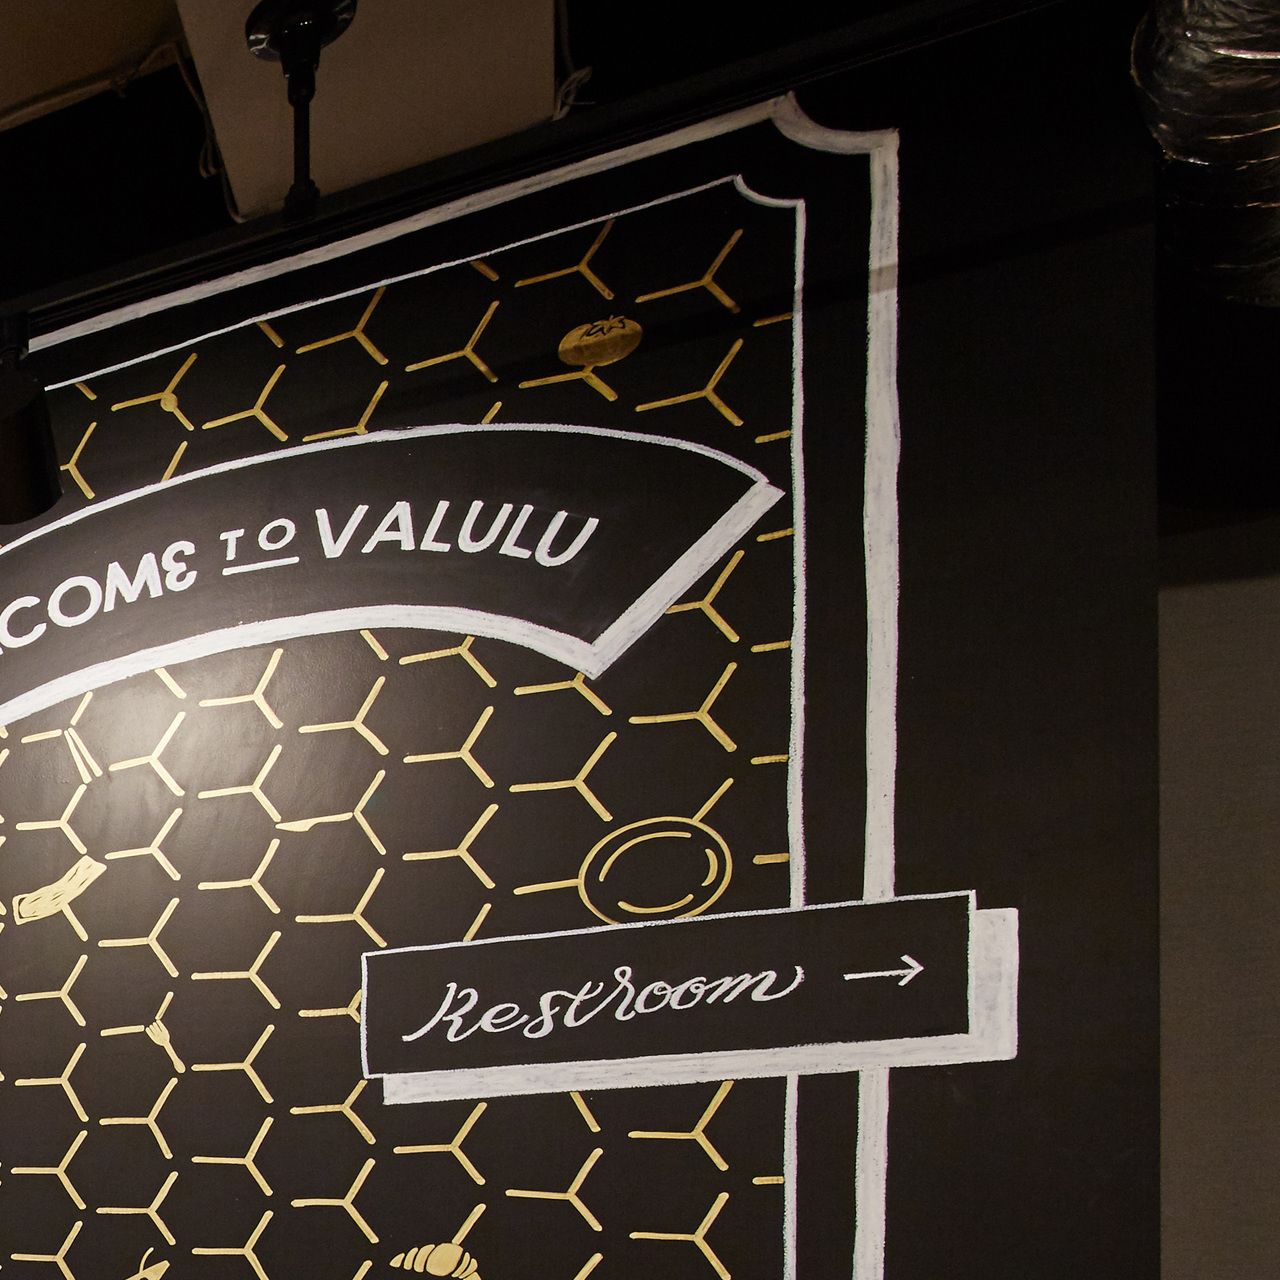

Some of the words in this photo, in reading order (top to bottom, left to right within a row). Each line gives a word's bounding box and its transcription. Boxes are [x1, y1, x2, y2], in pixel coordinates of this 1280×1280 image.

[219, 517, 297, 561] TO
[314, 499, 599, 568] VALULU
[402, 966, 804, 1042] Restroom
